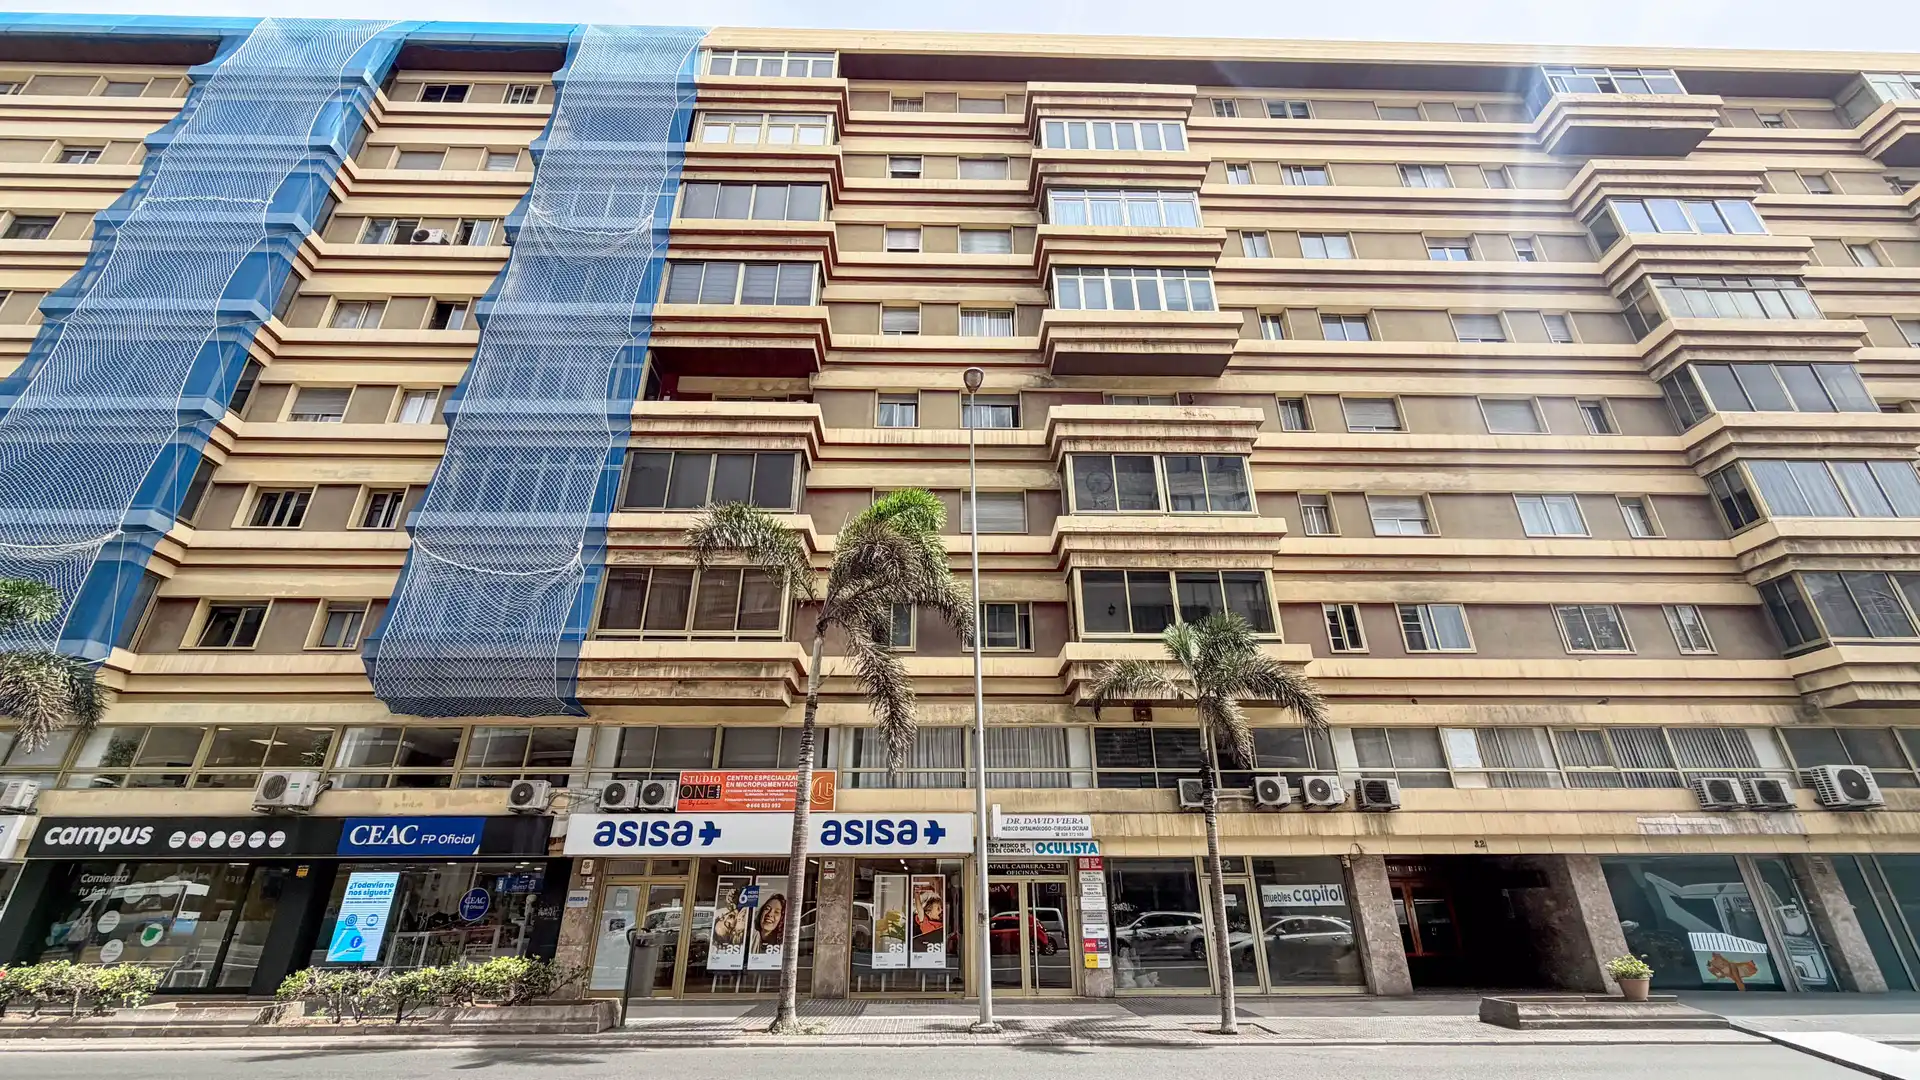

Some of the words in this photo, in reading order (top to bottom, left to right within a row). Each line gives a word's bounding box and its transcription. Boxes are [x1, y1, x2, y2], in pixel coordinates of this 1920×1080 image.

[682, 775, 721, 784] STUDIO
[754, 774, 799, 782] ESPECIALIZA
[680, 784, 715, 799] ONE
[1006, 817, 1021, 825] DR.
[1023, 817, 1054, 825] DAVID
[1056, 817, 1084, 825] VIERA
[349, 825, 419, 846] CEAC
[420, 834, 436, 845] FP
[438, 833, 475, 845] Oficial
[593, 820, 693, 847] asisa
[820, 819, 918, 846] asisa
[44, 826, 154, 852] campus
[1035, 842, 1099, 854] OCULISTA
[80, 873, 127, 883] Comienza
[78, 886, 89, 896] tu
[362, 889, 392, 898] sigues?
[738, 888, 748, 904] 6
[1263, 892, 1292, 903] muebles
[1292, 885, 1343, 905] capitol
[464, 896, 487, 904] CEAC
